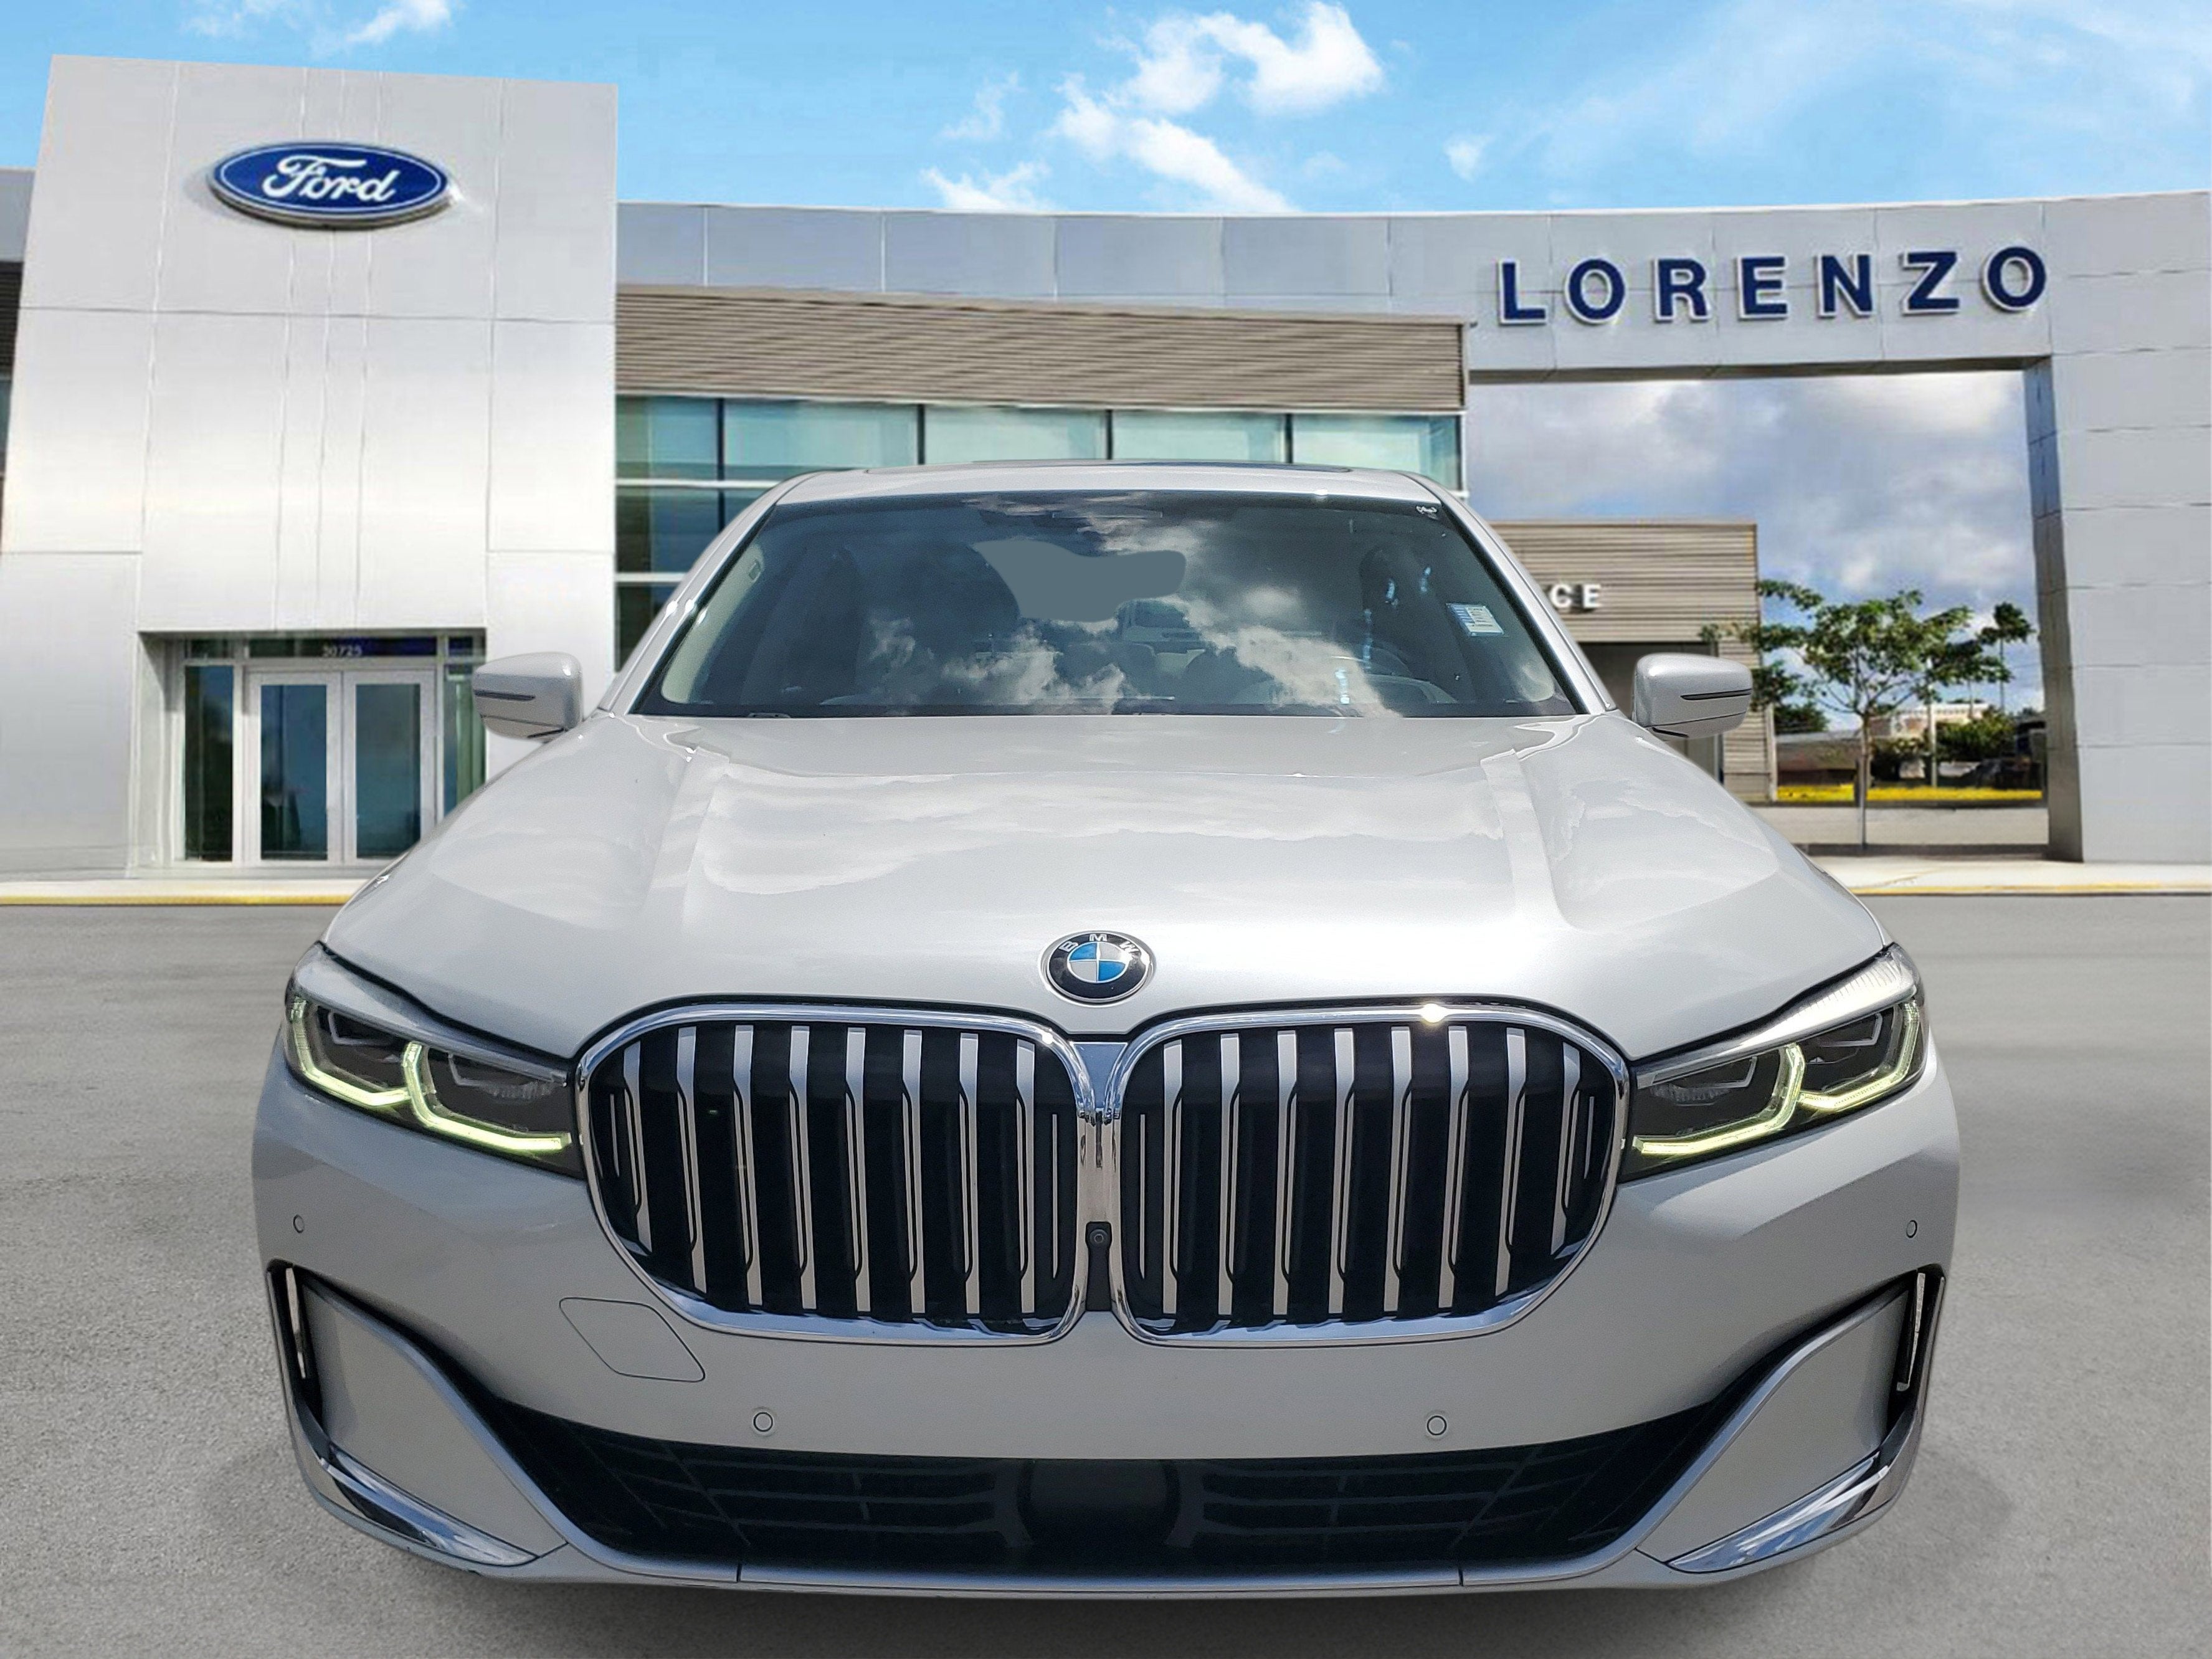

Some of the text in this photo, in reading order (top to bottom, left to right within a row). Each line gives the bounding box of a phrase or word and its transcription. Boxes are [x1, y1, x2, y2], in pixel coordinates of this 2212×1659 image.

[262, 154, 401, 202] Ford
[1496, 245, 2048, 325] LORENZO
[1549, 583, 1603, 609] CE
[1059, 933, 1139, 953] BMW
